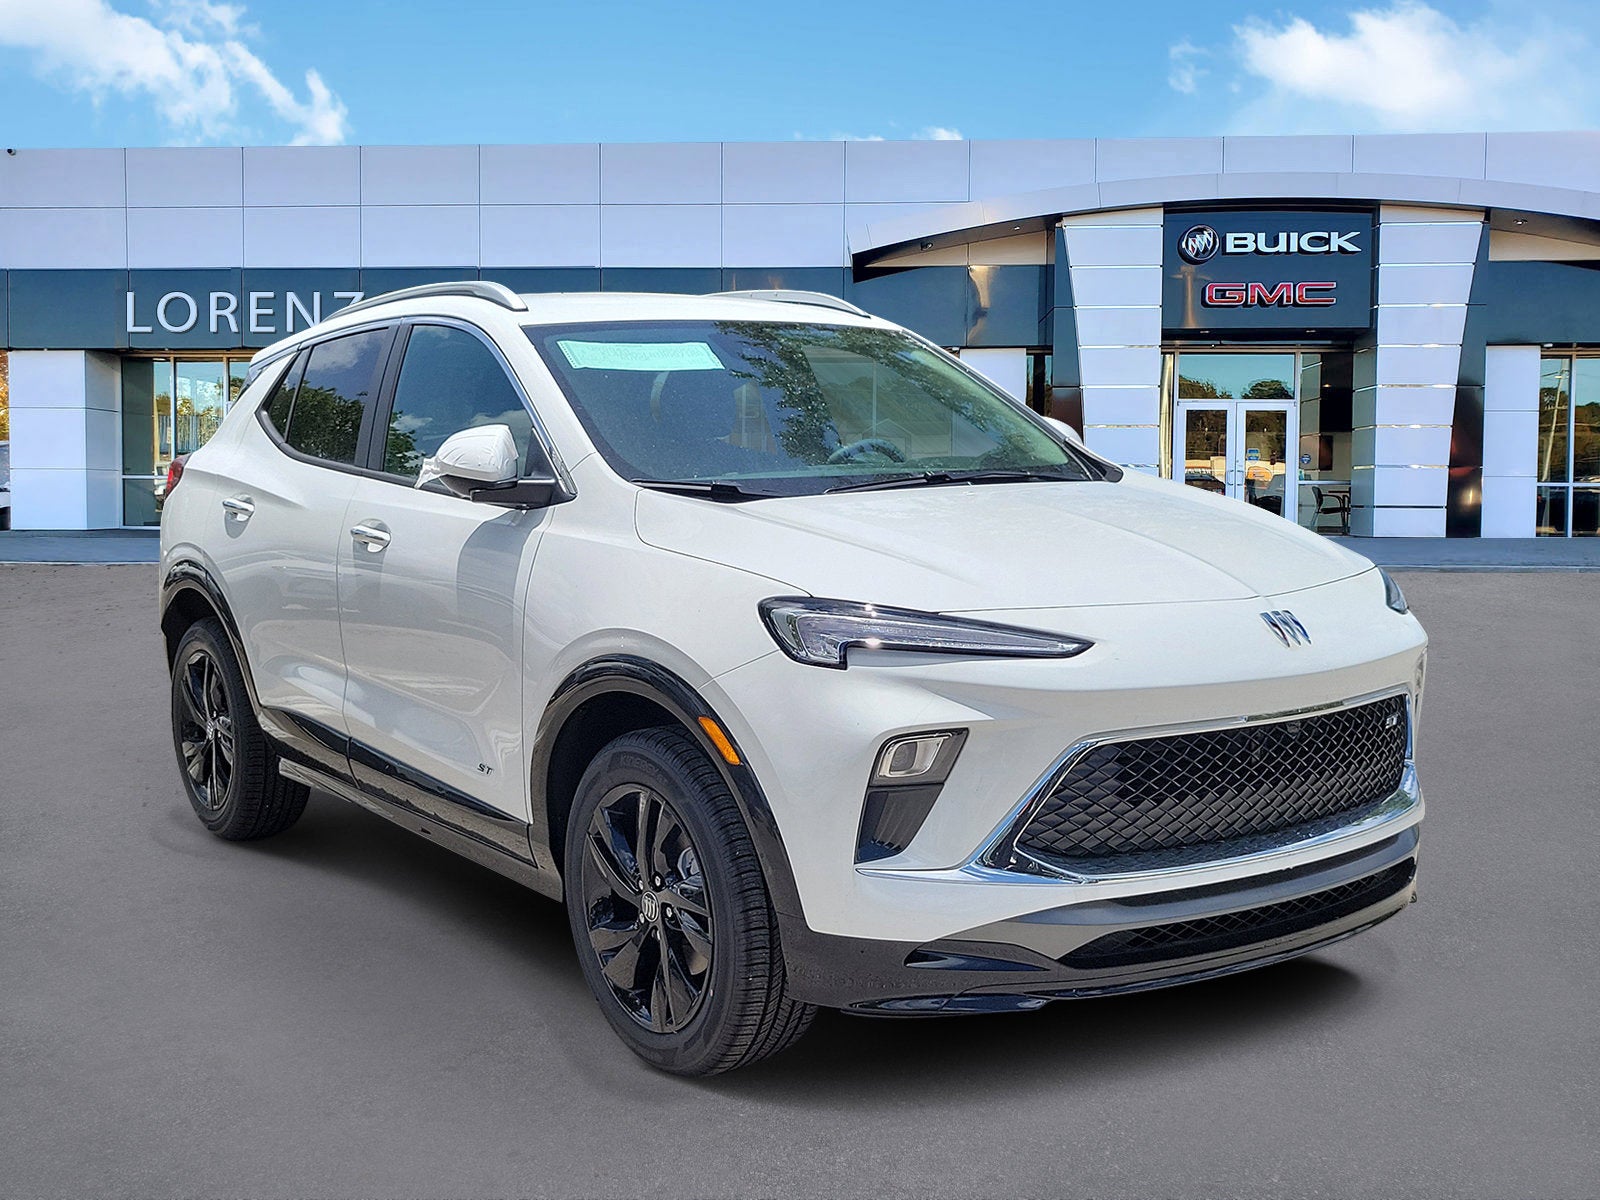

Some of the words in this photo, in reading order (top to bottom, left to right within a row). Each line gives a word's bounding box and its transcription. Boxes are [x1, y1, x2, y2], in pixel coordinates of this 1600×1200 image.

[1224, 231, 1362, 254] BUICK
[1204, 282, 1337, 306] GMC
[477, 762, 493, 775] ST
